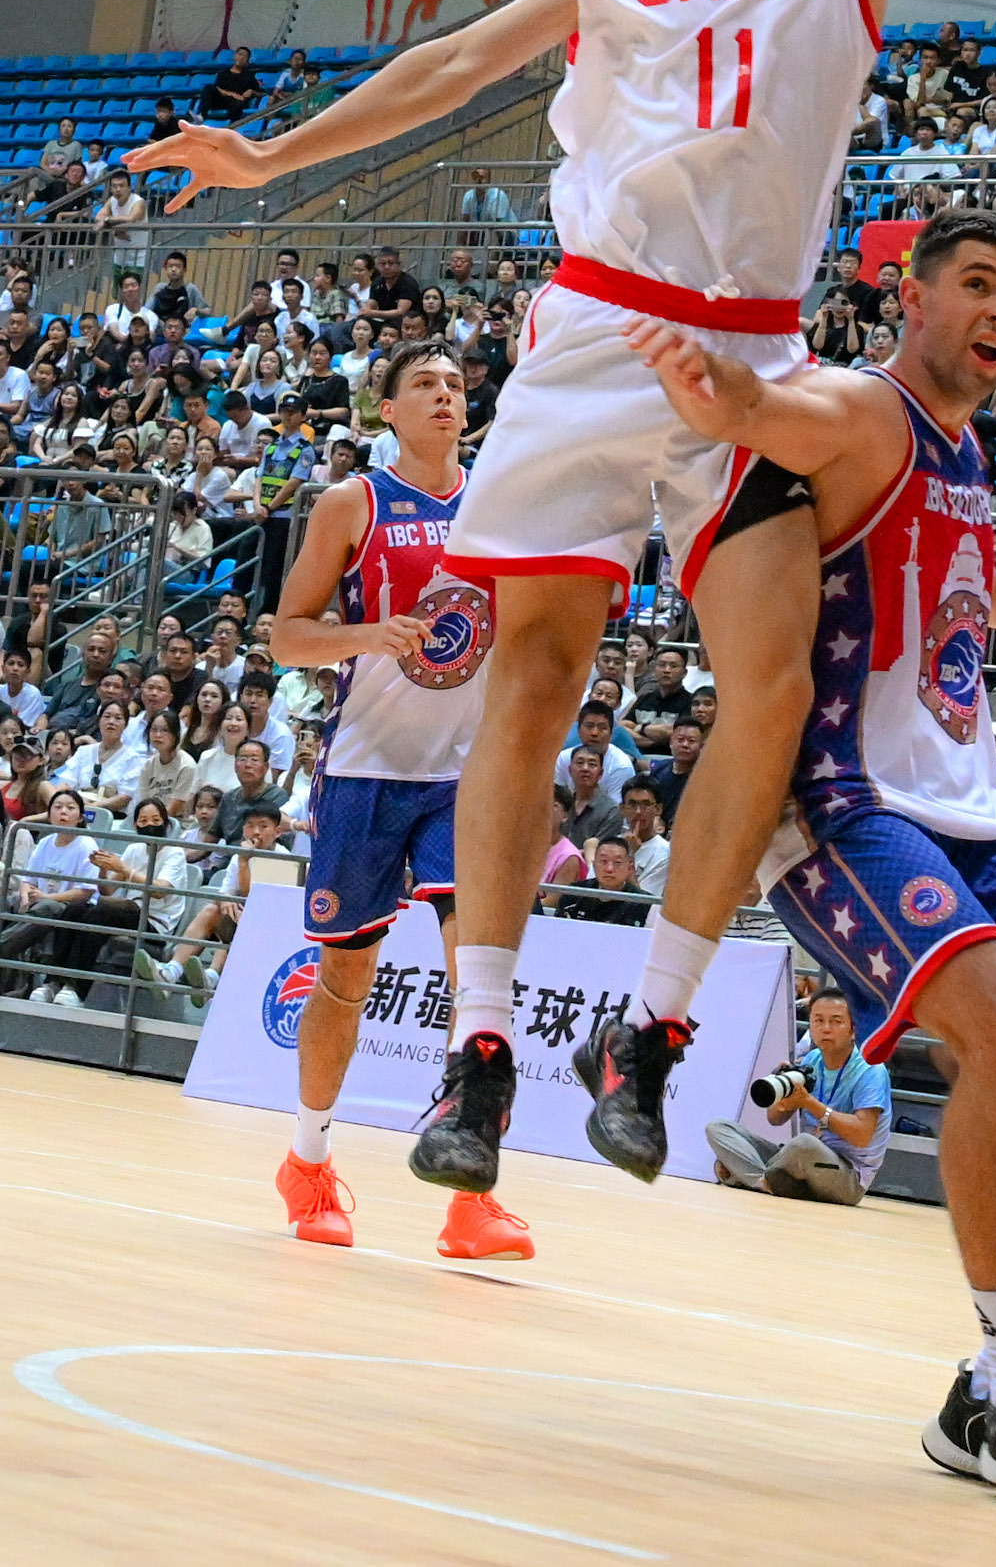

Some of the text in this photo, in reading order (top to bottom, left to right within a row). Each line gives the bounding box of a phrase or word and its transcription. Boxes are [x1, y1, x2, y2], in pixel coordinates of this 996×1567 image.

[696, 27, 754, 130] 11
[385, 519, 457, 548] IBC BE
[361, 961, 701, 1065] 新疆球协
